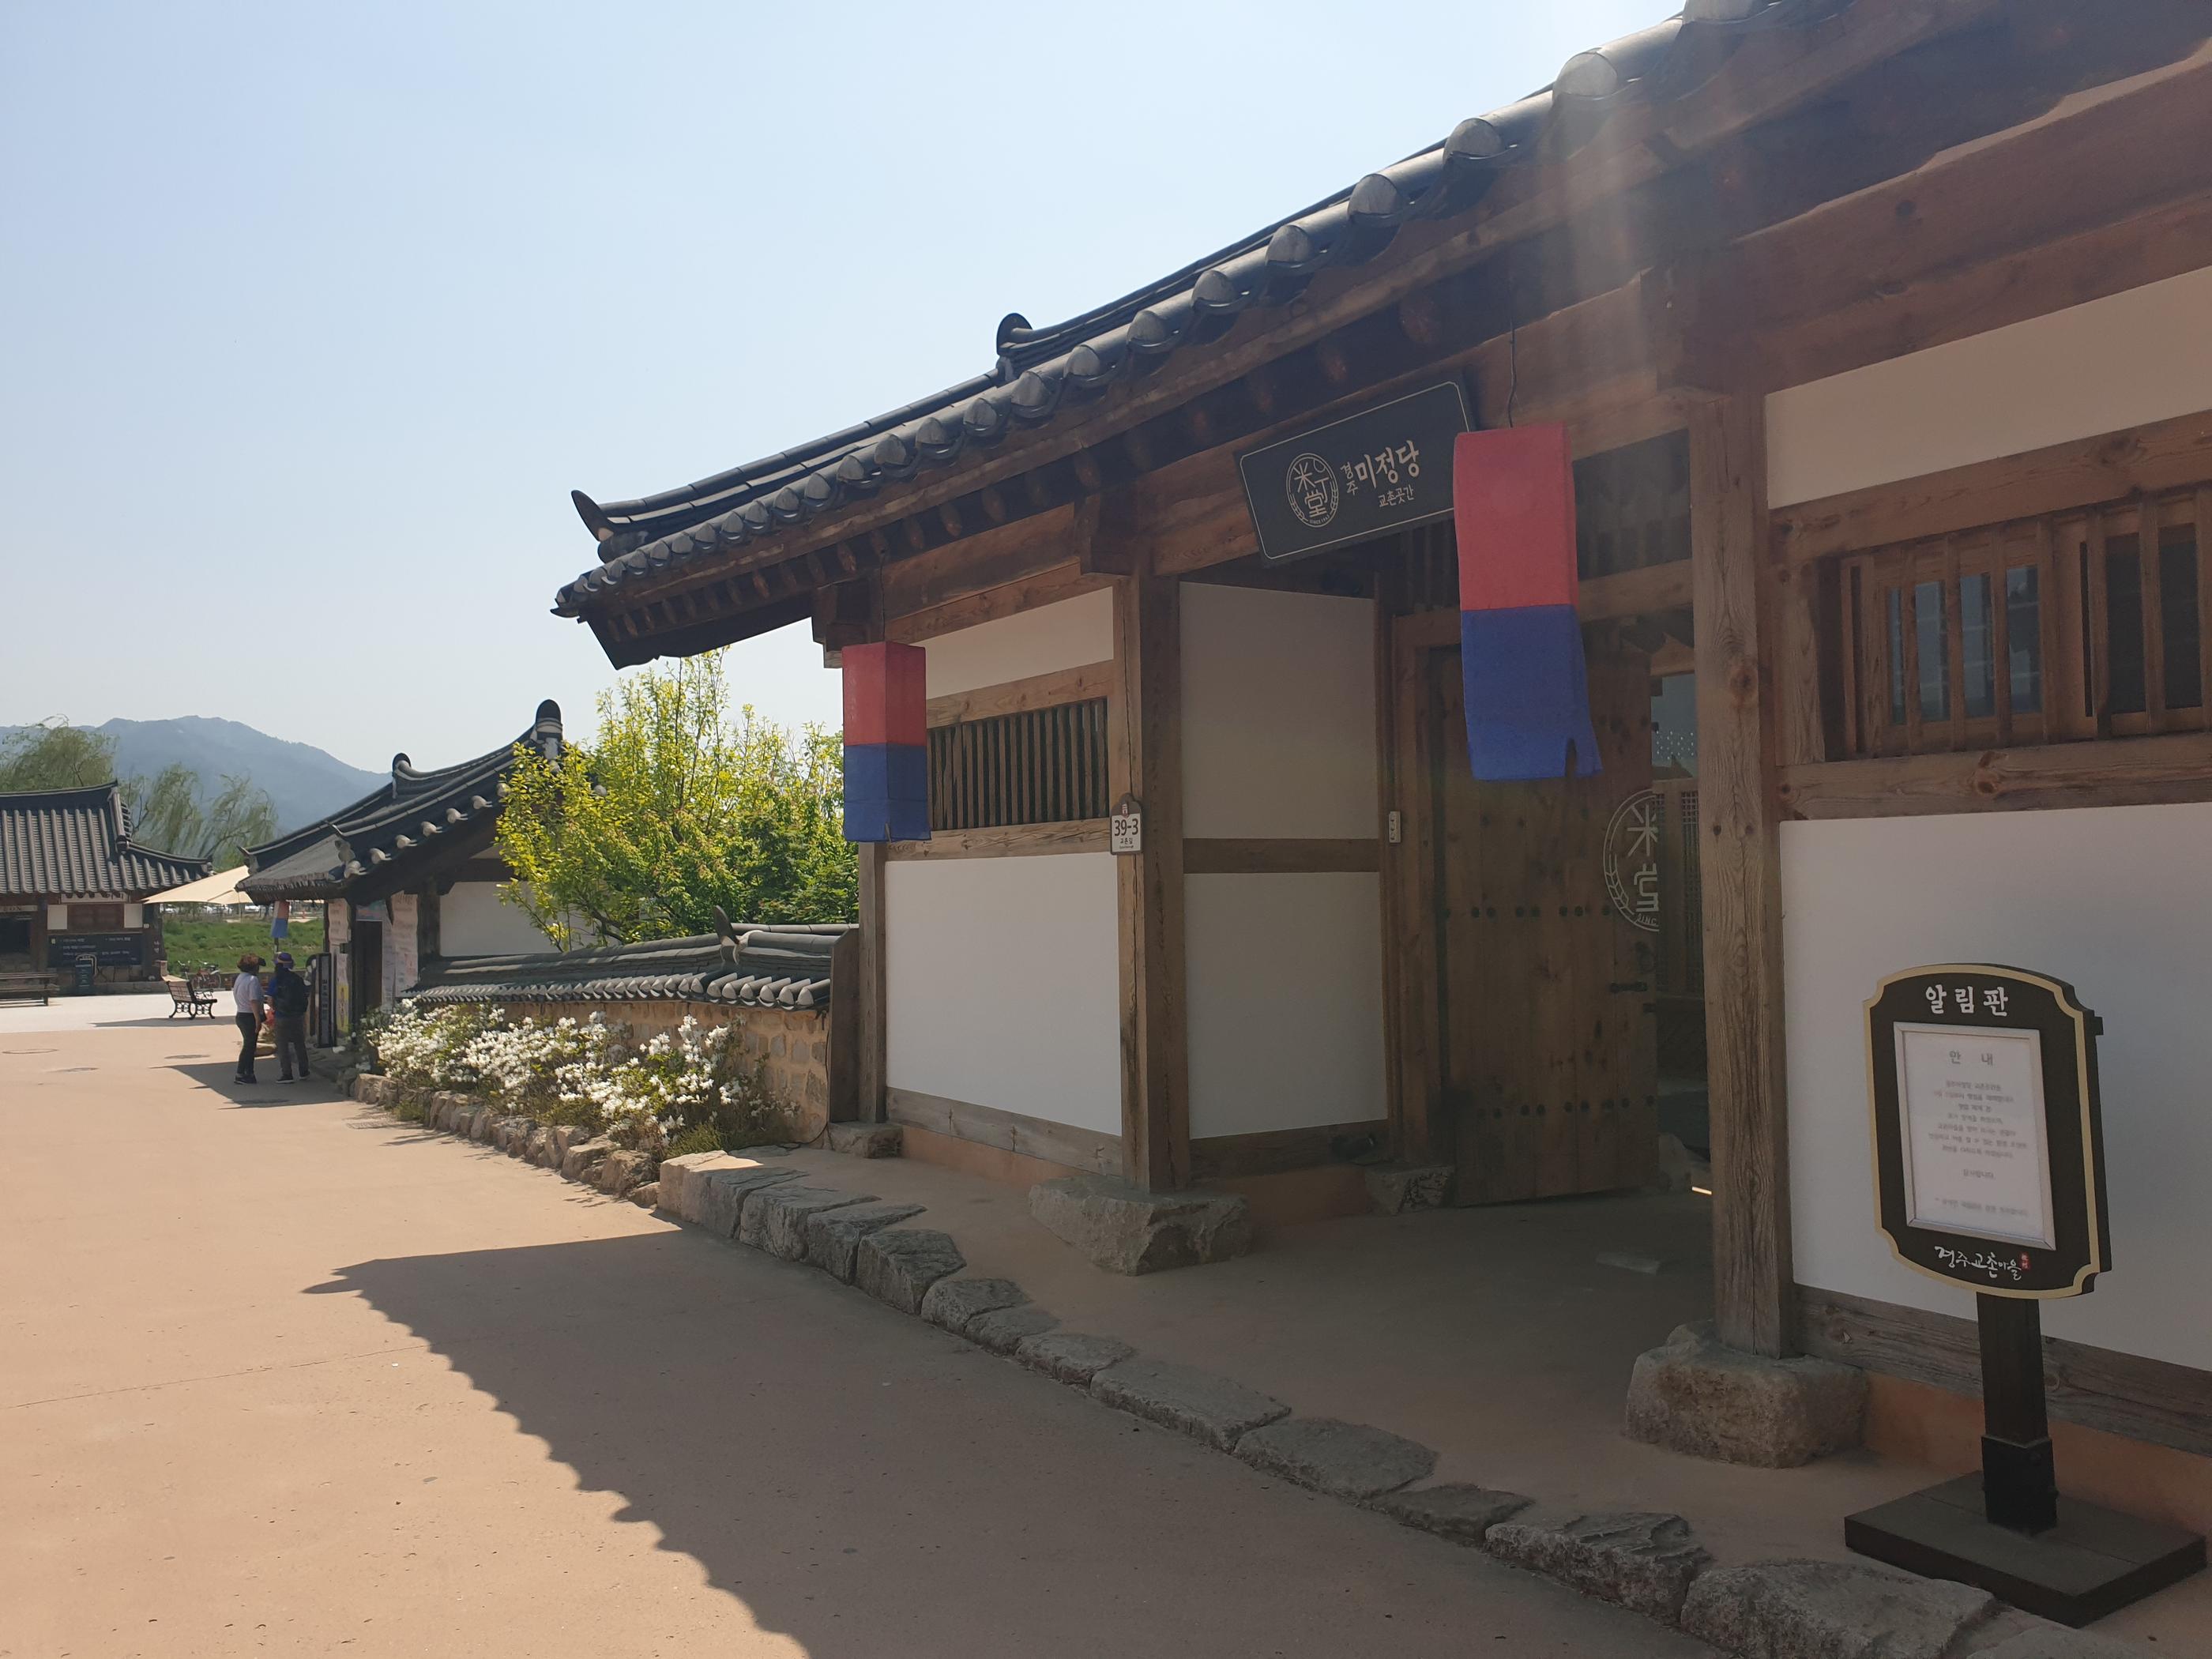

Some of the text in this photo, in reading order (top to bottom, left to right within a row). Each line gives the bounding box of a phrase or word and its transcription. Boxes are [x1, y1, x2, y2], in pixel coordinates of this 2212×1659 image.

[1340, 439, 1420, 495] 경주 미정당
[1378, 484, 1414, 507] 교촌곳간
[1114, 818, 1138, 836] 39-3
[1637, 913, 1657, 925] SINC
[1925, 984, 2008, 1017] 알림판
